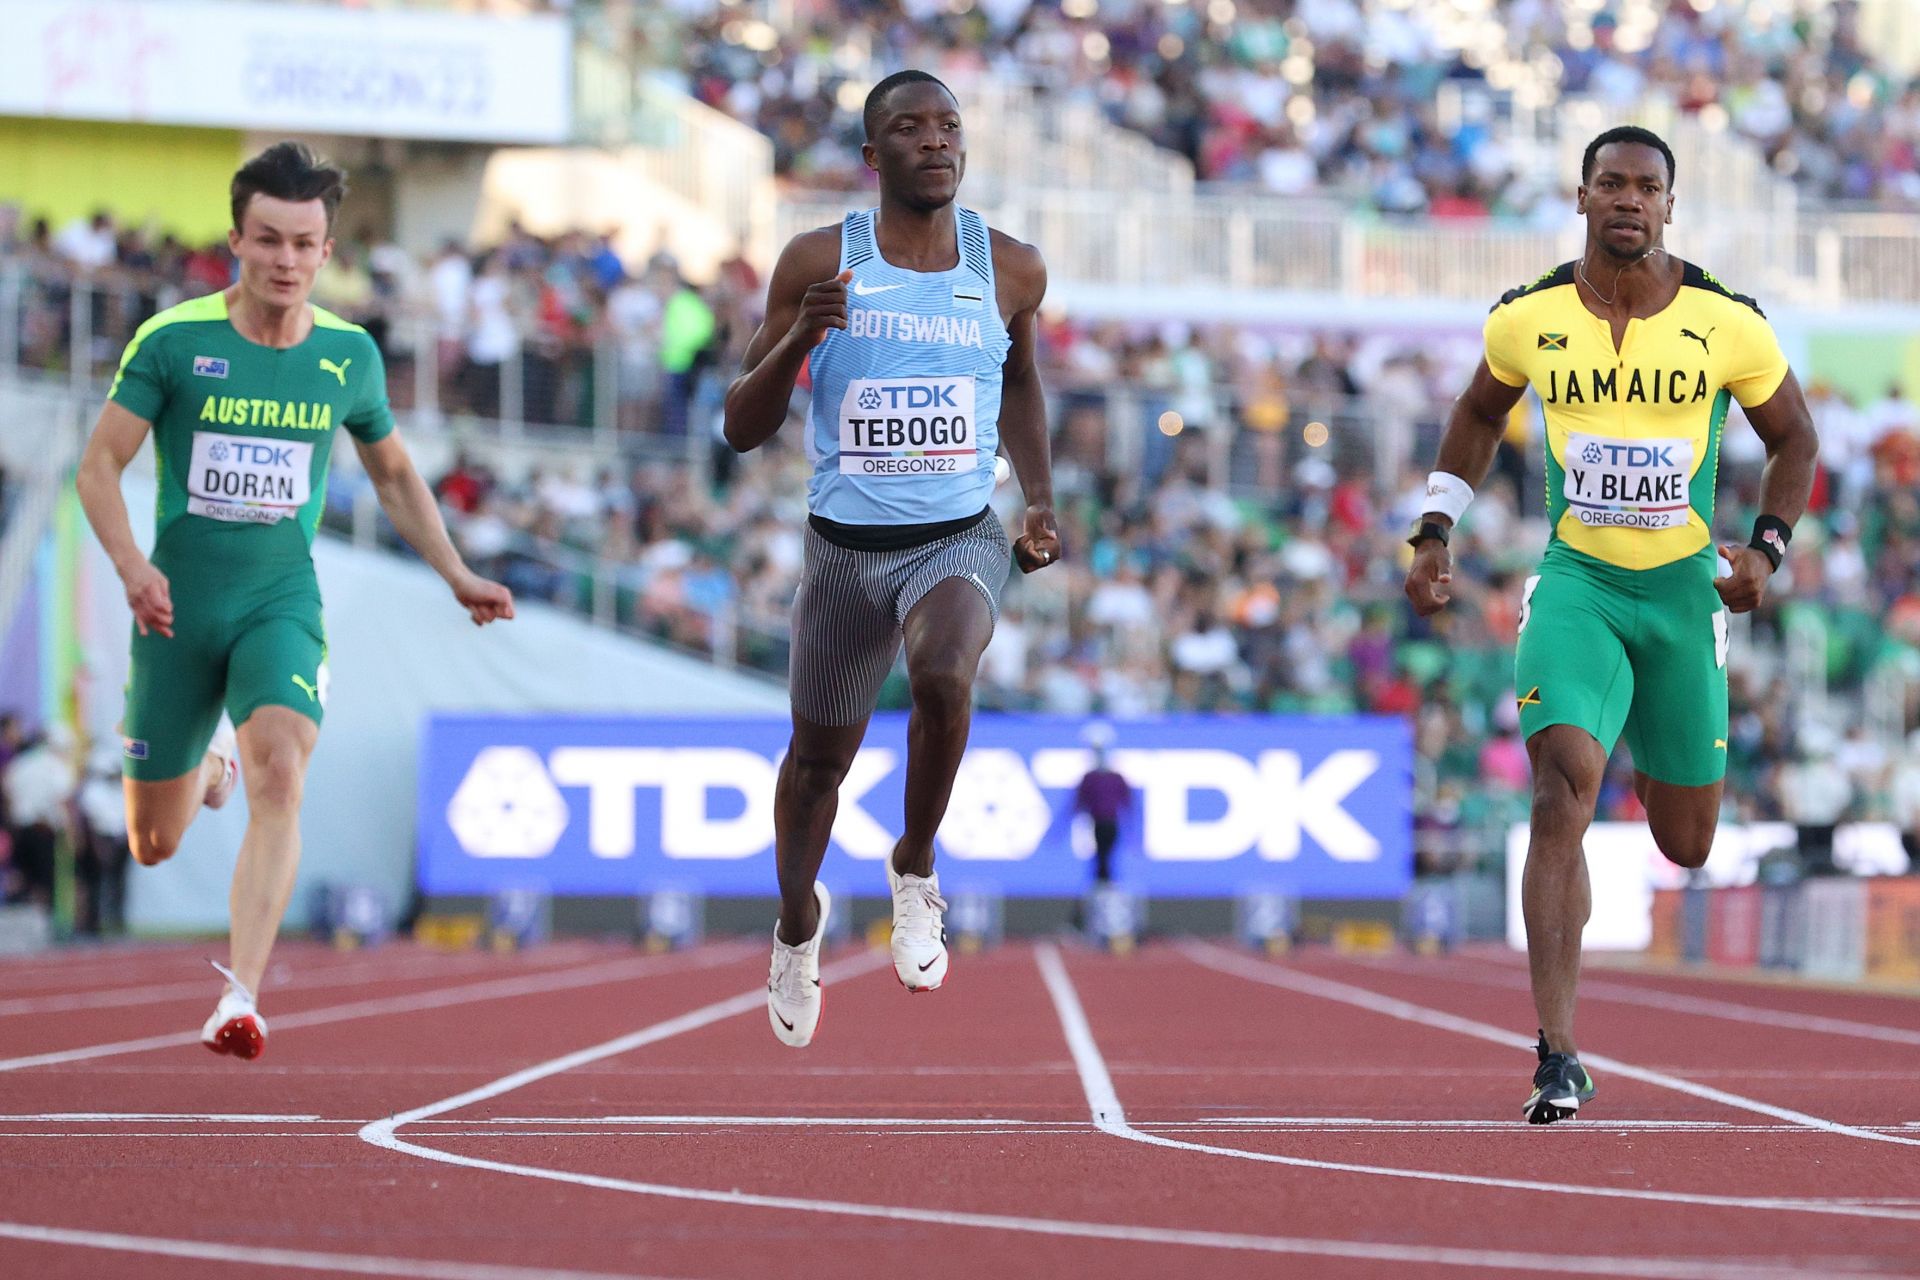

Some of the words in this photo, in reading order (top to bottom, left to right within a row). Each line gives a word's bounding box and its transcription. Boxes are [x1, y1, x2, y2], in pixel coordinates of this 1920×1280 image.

[851, 309, 982, 348] BOTSWANA
[881, 384, 957, 408] TDK
[1547, 368, 1707, 404] JAMAICA
[200, 395, 332, 431] AUSTRALIA
[848, 416, 967, 446] TEBOGO
[231, 443, 294, 468] TDK
[863, 458, 956, 473] OREGON22
[1602, 445, 1674, 468] TDK
[204, 469, 294, 500] DORAN
[1572, 469, 1592, 498] Y.
[1601, 473, 1682, 502] BLAKE
[1580, 510, 1670, 527] OREGON22
[1030, 748, 1381, 862] TDK
